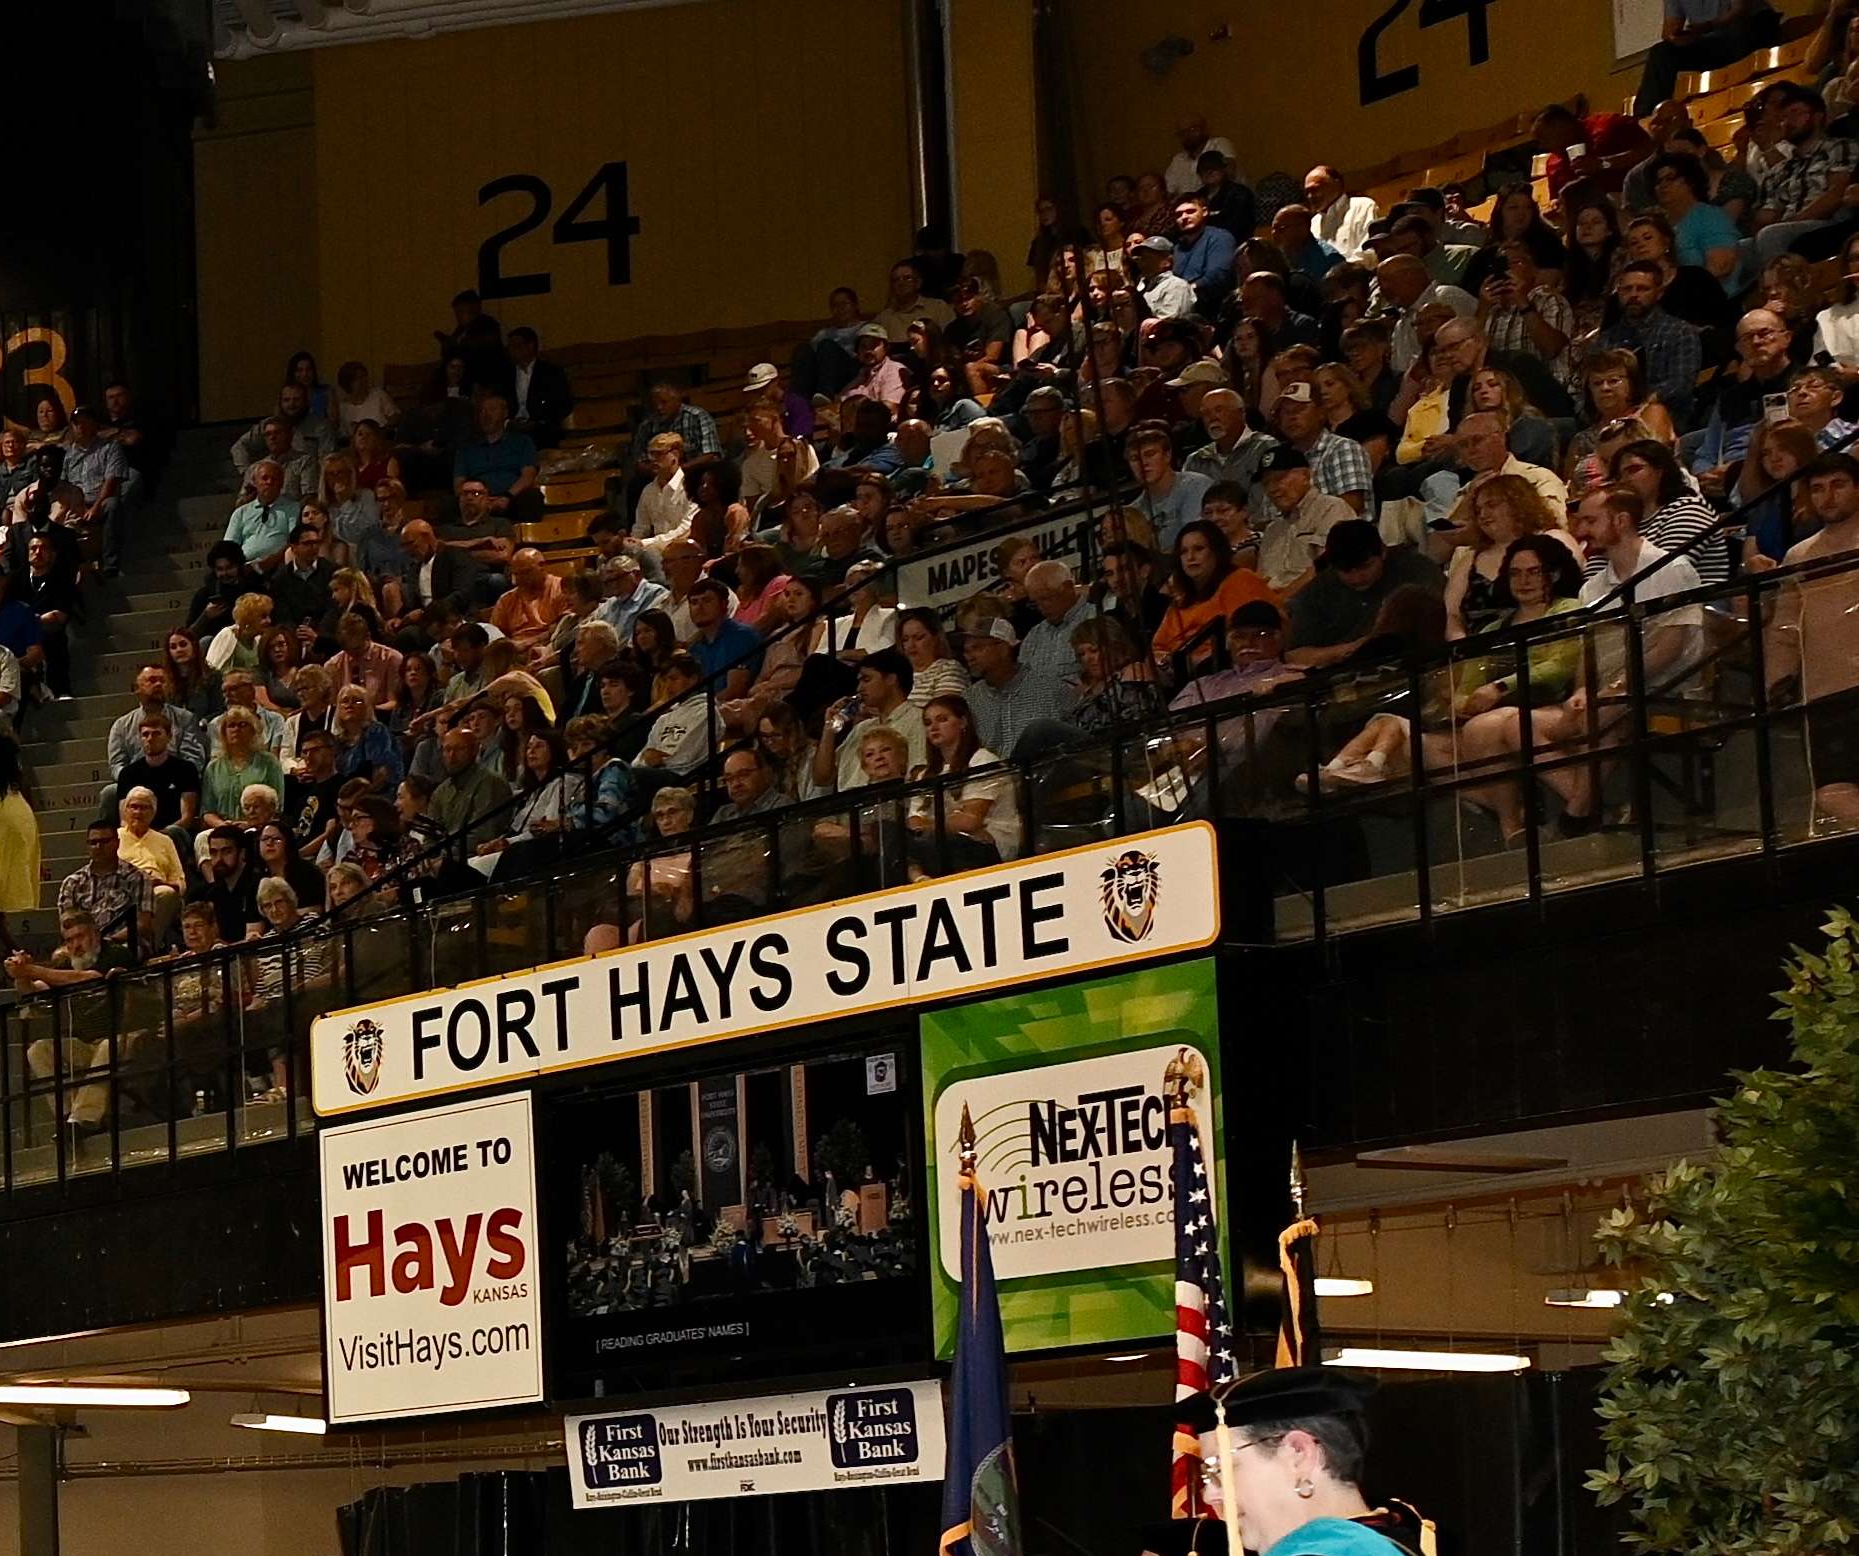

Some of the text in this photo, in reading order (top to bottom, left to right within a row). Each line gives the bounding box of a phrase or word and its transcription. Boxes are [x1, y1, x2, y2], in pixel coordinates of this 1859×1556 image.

[478, 162, 639, 298] 24
[928, 546, 1000, 595] MAPES
[412, 872, 1069, 1081] FORT HAYS STATE
[342, 1137, 512, 1191] WELCOME TO
[333, 1207, 526, 1307] Hays
[473, 1283, 528, 1305] KANSAS
[339, 1322, 530, 1371] VisitHays.com
[602, 1335, 644, 1350] READING
[708, 1323, 743, 1338] NAMES
[856, 1398, 898, 1418] First
[605, 1423, 643, 1441] First
[658, 1407, 825, 1448] Our Strength Is Your Security
[847, 1420, 911, 1440] Kansas
[598, 1443, 656, 1462] Kansas
[857, 1441, 906, 1460] Bank
[608, 1463, 651, 1481] Bank
